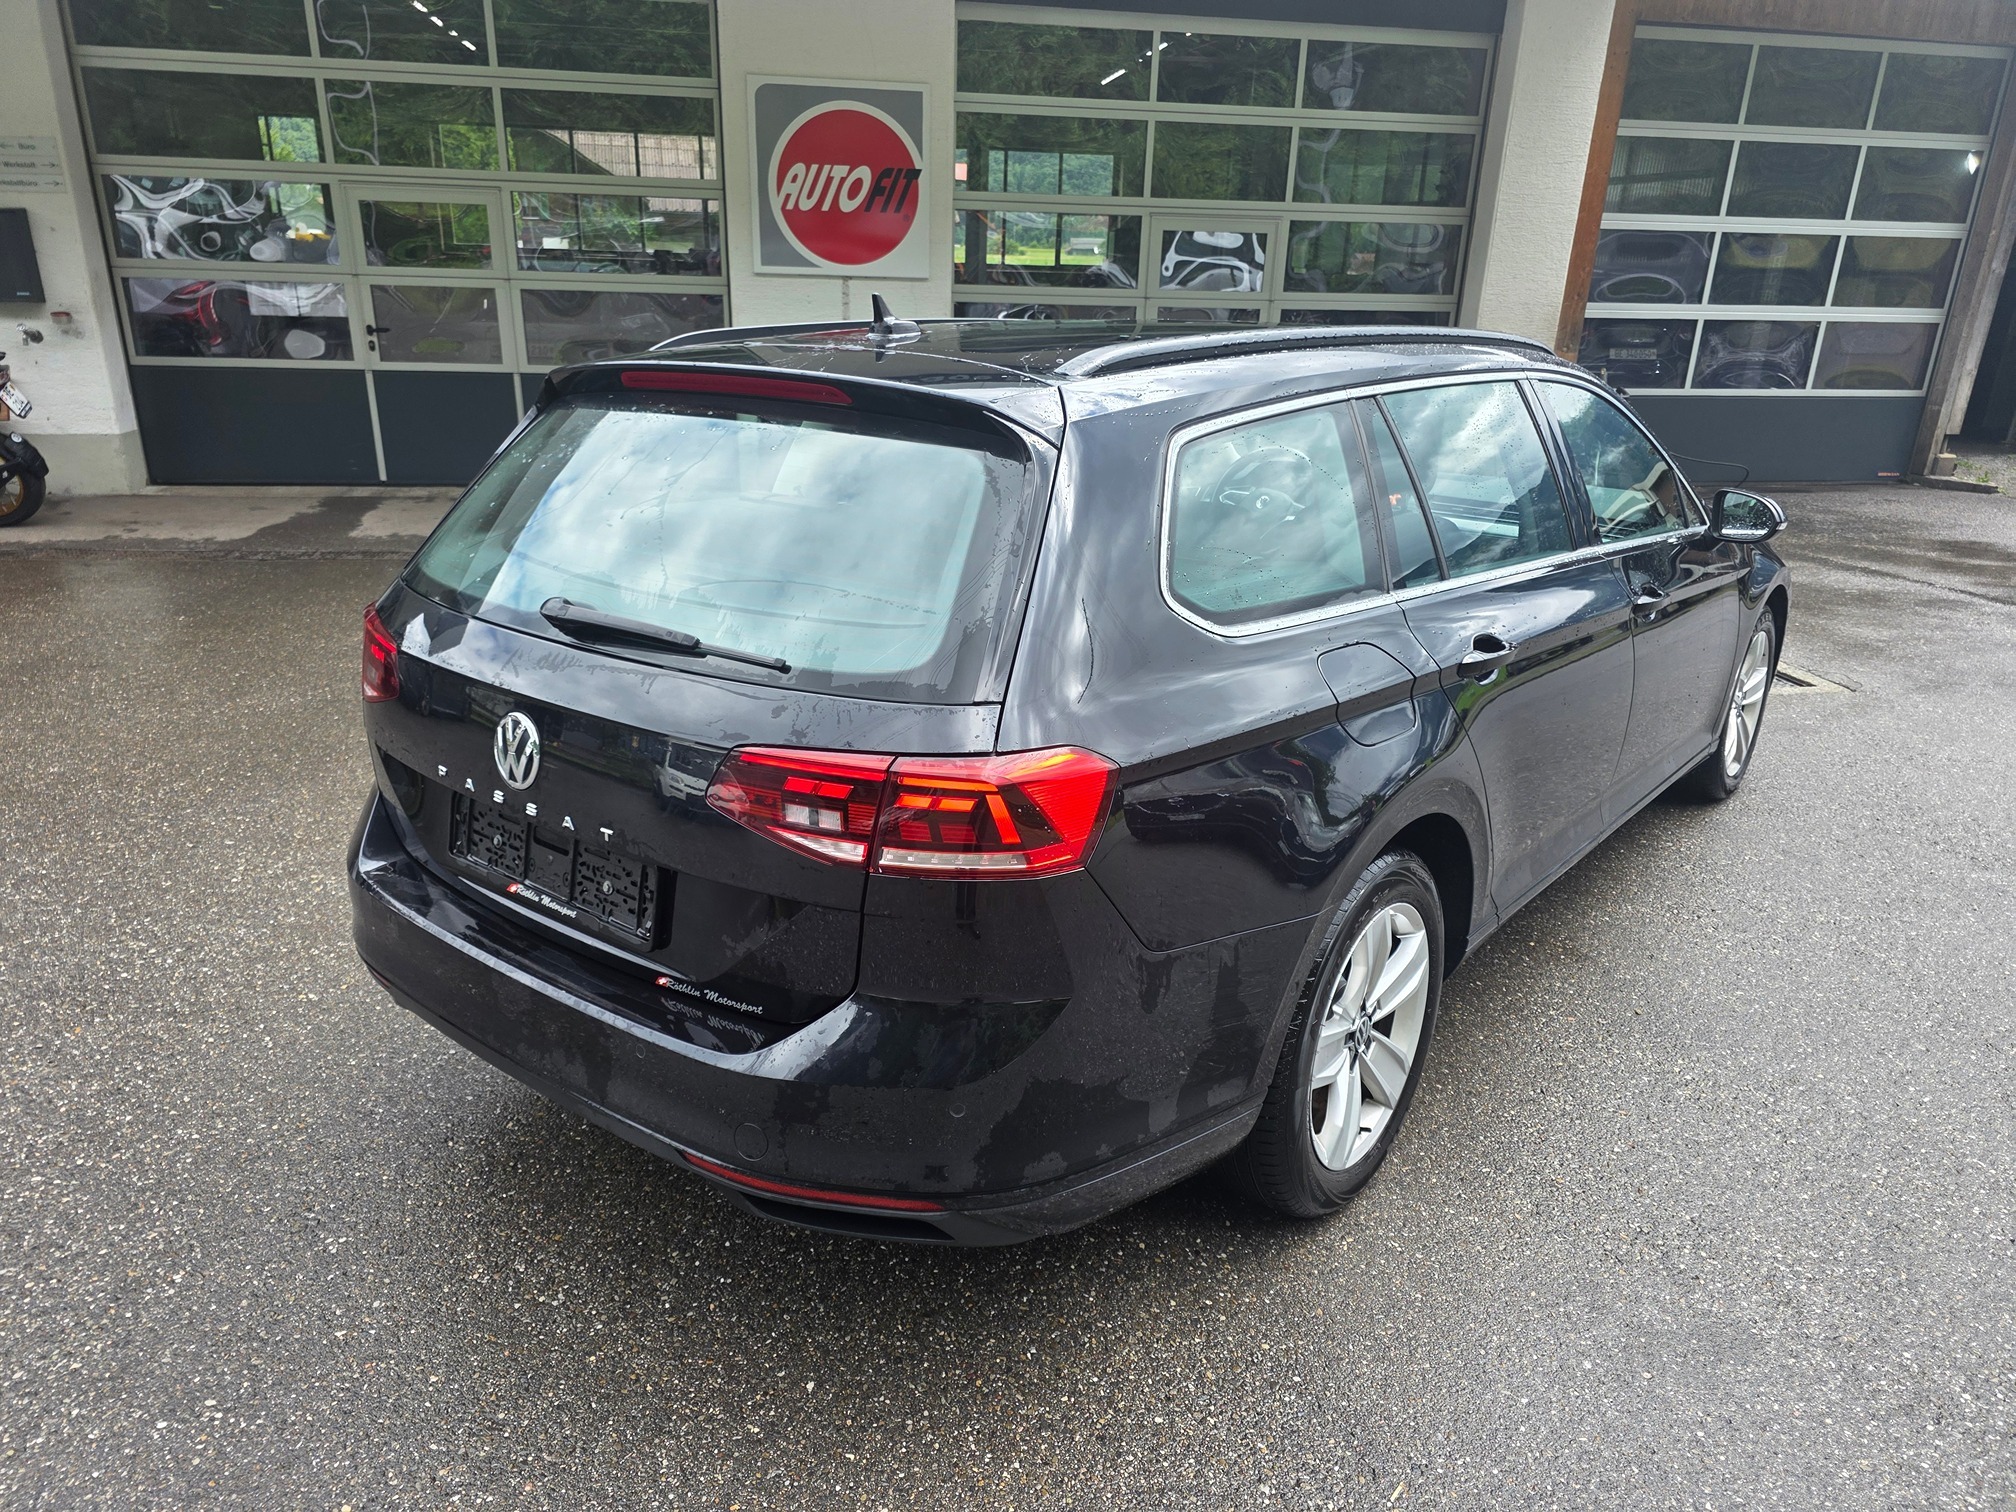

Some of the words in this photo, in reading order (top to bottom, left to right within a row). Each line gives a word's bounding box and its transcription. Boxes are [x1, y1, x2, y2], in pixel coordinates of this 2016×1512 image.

[778, 163, 922, 214] AUTOFIT
[437, 764, 614, 842] PASSAT
[541, 894, 577, 918] Motorsport
[666, 978, 701, 997] Röthlin
[703, 989, 763, 1015] Motorsport
